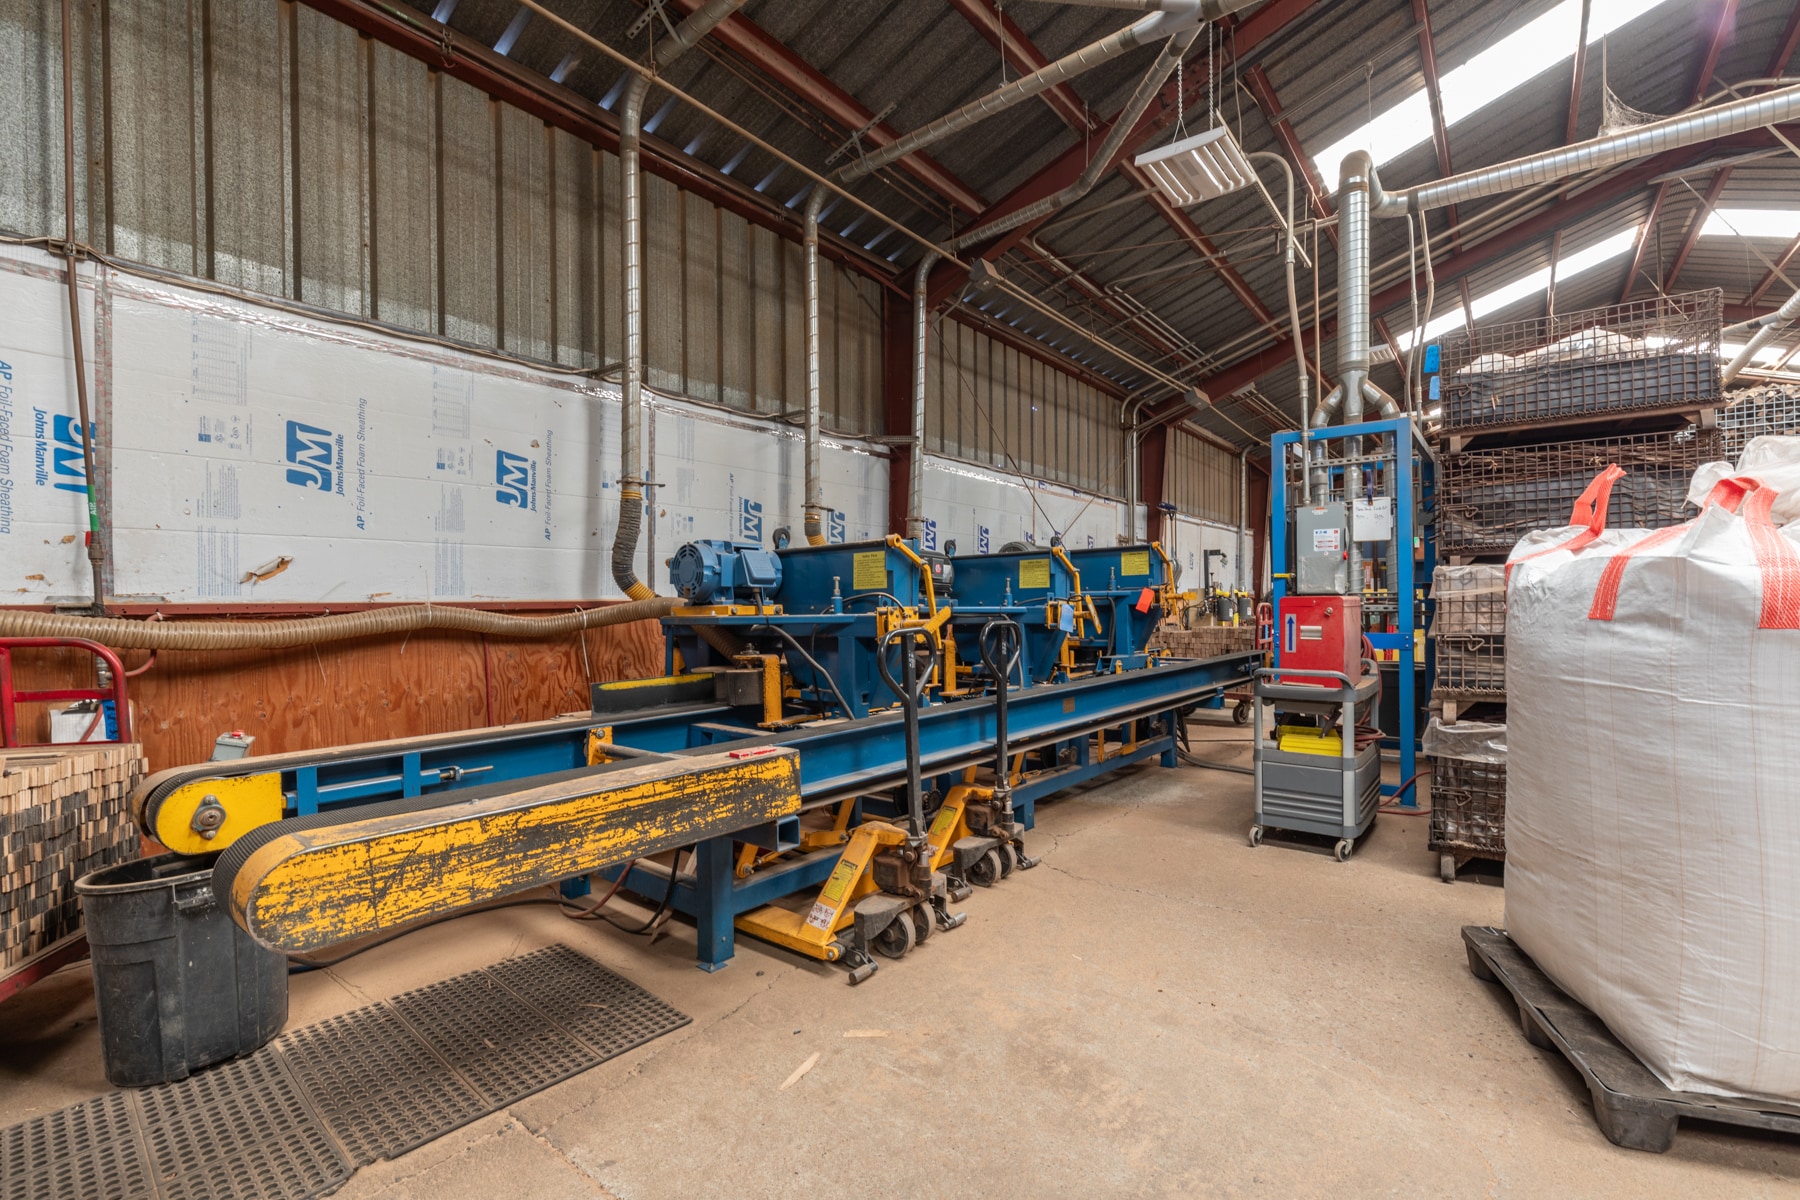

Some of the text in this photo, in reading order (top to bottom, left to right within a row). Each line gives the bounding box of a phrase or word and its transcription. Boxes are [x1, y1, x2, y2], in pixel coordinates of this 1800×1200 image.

[0, 359, 12, 380] AP
[0, 443, 13, 475] Foam
[33, 406, 48, 486] Johns Manville
[286, 420, 332, 492] JM
[335, 434, 345, 497] Johns Manville
[356, 398, 368, 530] AP Foil-Faced Foam Sheathing
[496, 449, 529, 509] JM
[743, 498, 762, 543] JM
